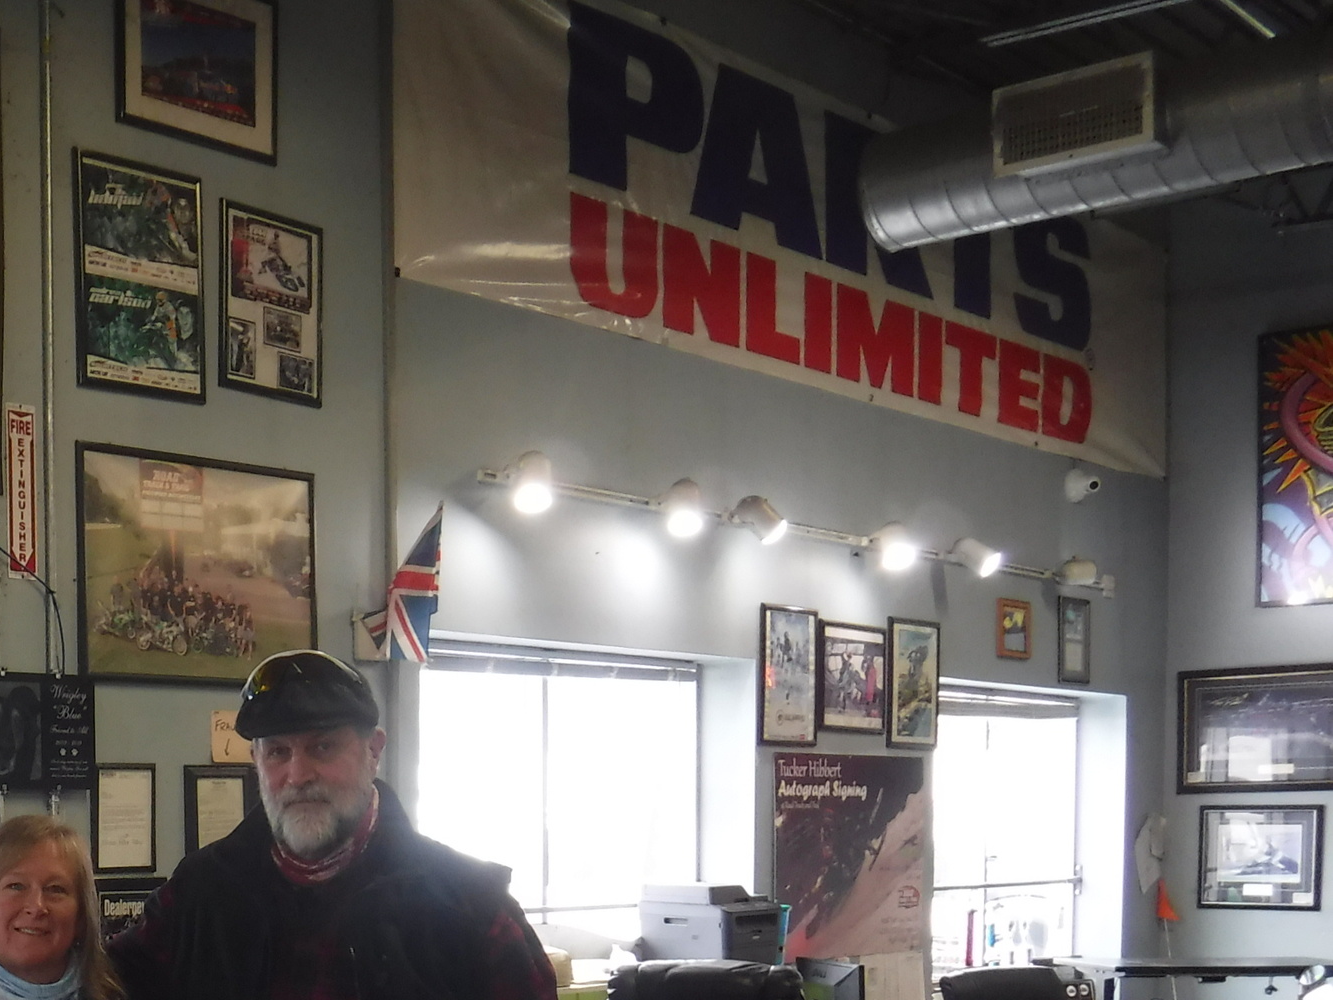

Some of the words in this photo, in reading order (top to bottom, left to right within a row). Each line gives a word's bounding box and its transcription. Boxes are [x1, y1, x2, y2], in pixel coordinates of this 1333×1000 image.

[569, 191, 1093, 444] UNLIMITED
[10, 419, 32, 436] FIRE
[17, 437, 27, 562] EXTINGUISHER
[50, 683, 87, 705] Wrigley
[778, 759, 808, 777] Tucker
[808, 759, 842, 778] Hibbert
[778, 779, 831, 800] Autograph
[832, 780, 868, 801] Signing
